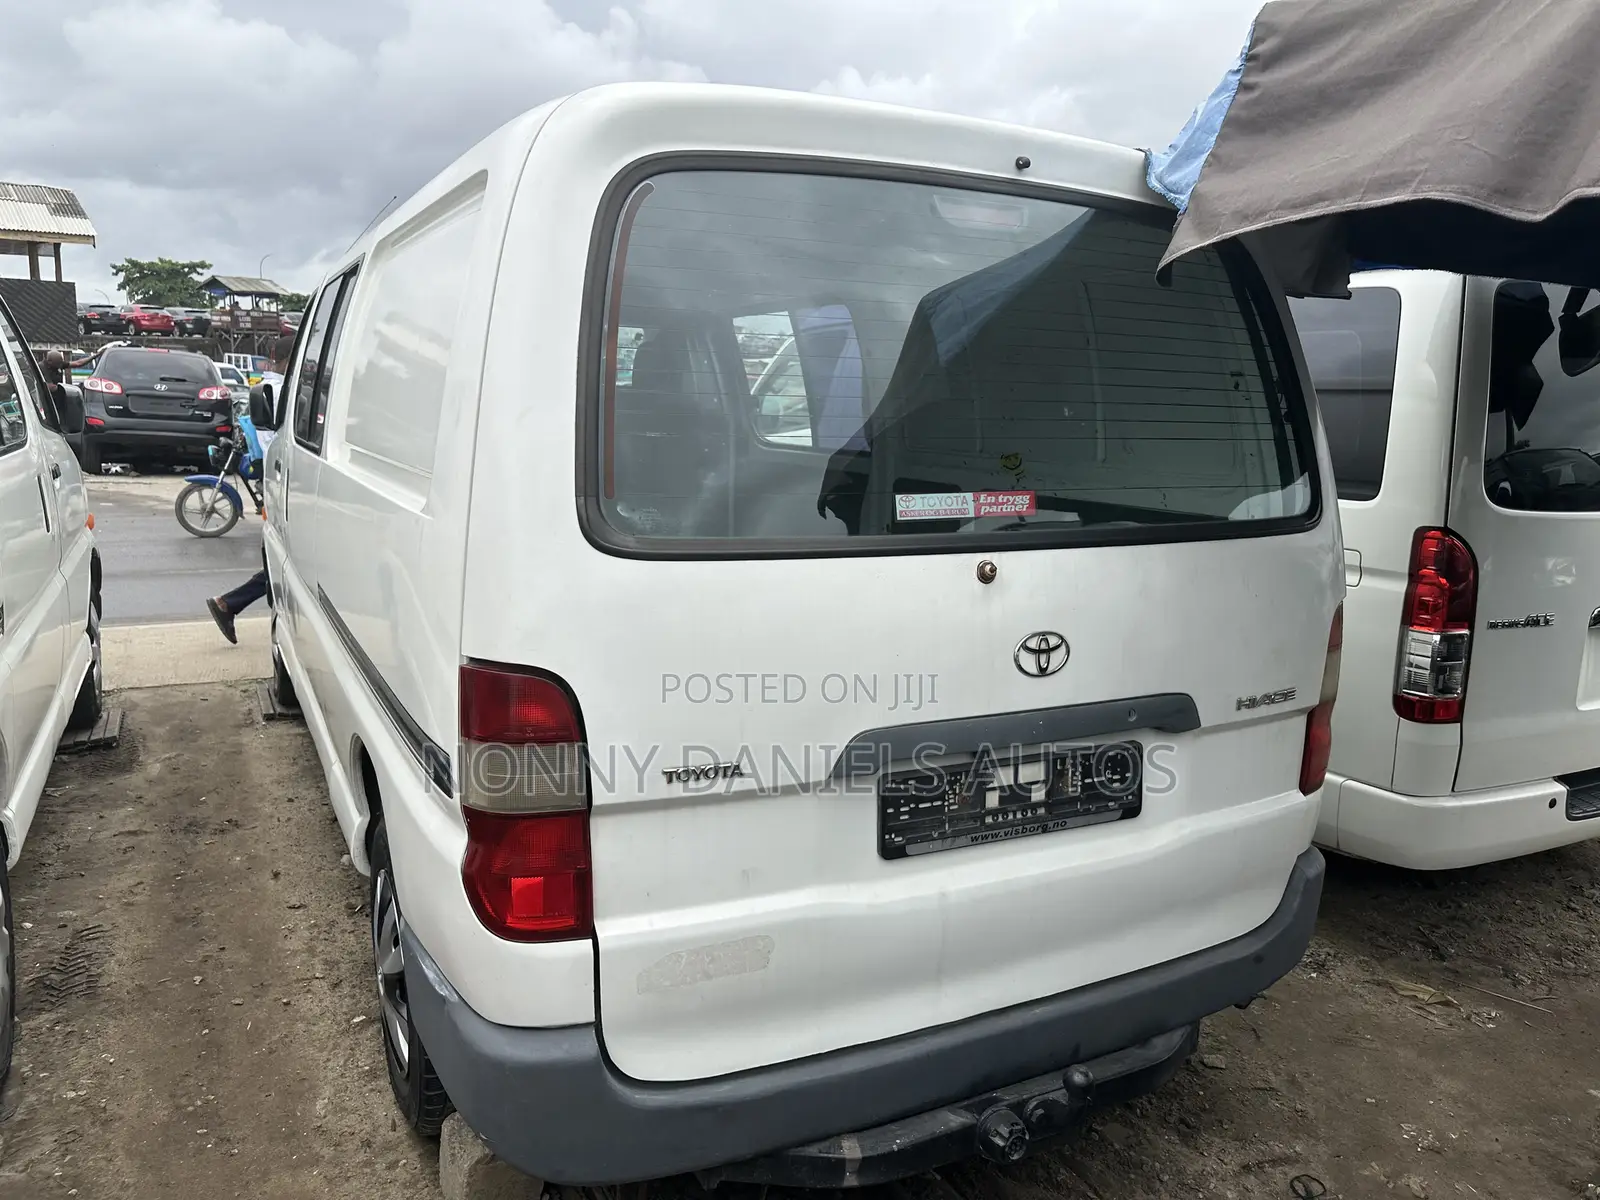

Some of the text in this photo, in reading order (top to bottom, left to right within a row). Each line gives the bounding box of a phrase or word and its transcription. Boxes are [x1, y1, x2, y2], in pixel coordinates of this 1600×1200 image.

[979, 493, 1031, 505] En trygg
[980, 503, 1029, 515] partner
[1236, 686, 1297, 712] HIACE
[662, 761, 744, 784] TOYOTA
[970, 819, 1068, 843] www.visborg.no
